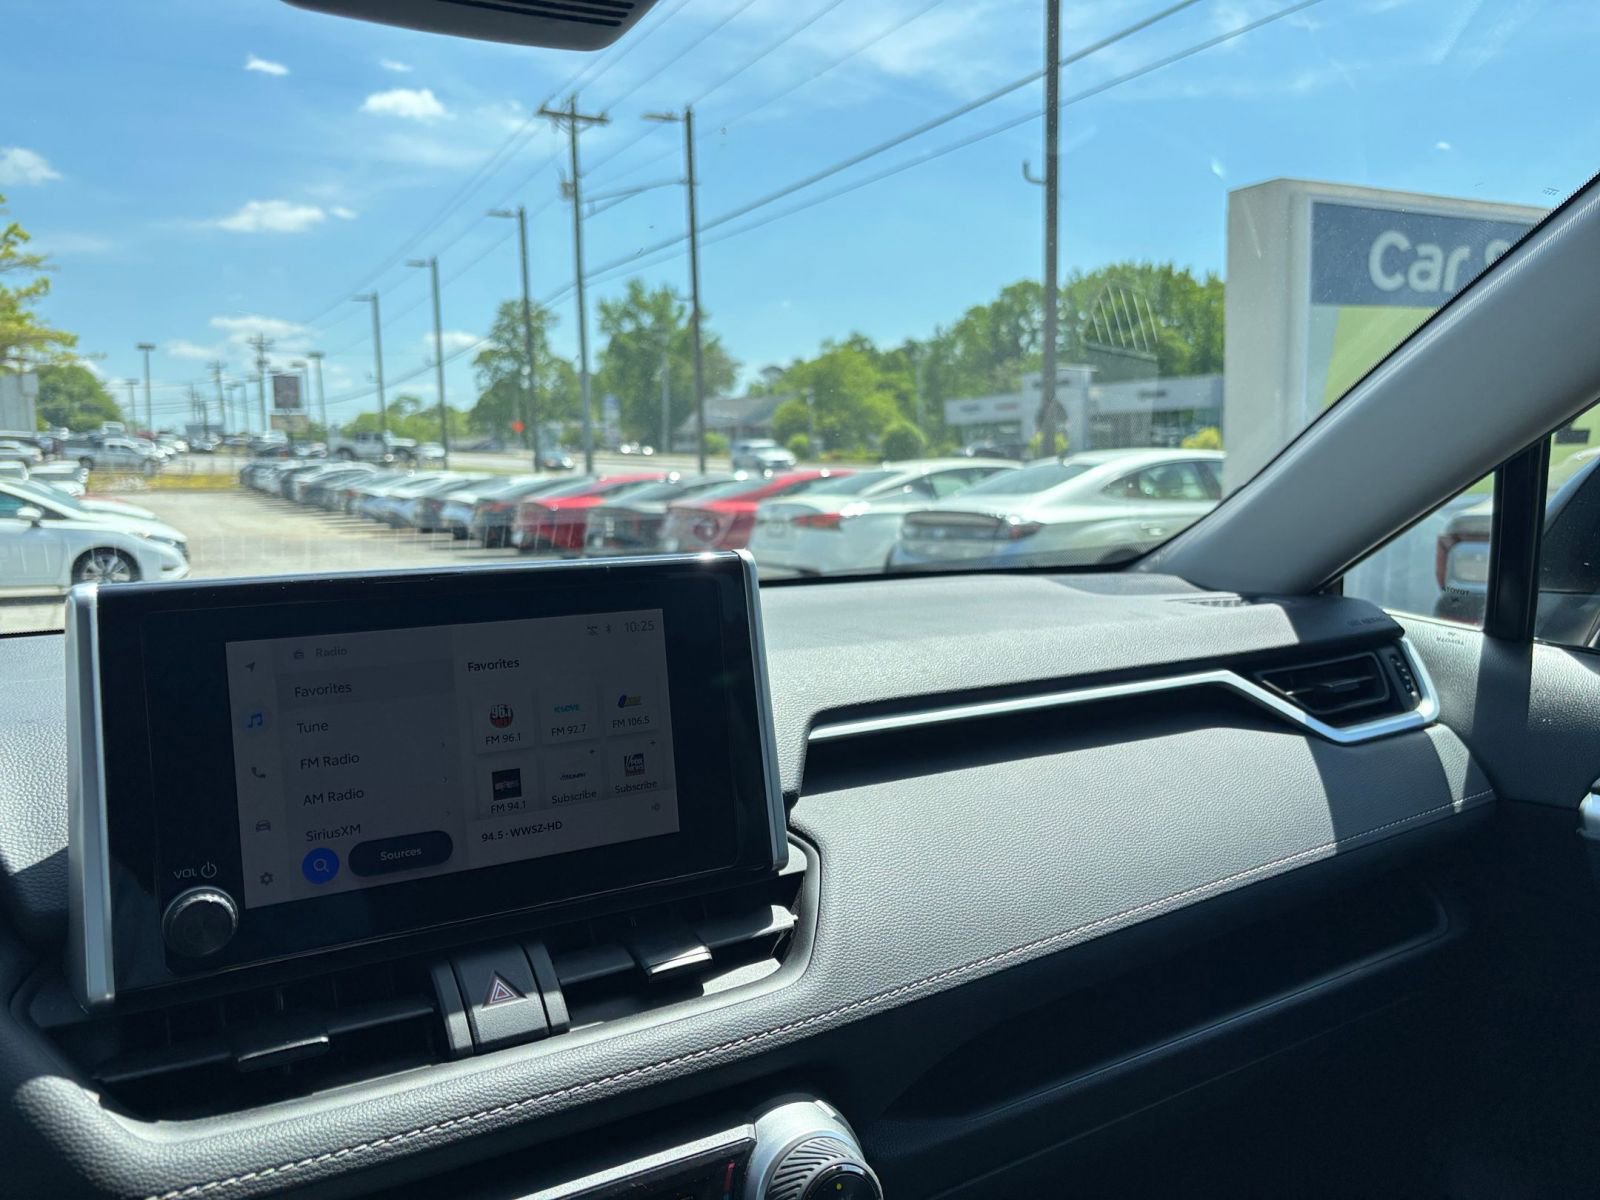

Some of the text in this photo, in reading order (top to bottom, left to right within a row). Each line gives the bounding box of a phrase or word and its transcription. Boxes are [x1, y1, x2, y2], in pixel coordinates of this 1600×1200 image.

[1367, 230, 1470, 293] Car
[624, 620, 655, 633] 10:25
[315, 646, 348, 658] Radio
[467, 657, 520, 673] Favorites
[294, 682, 352, 698] Favorites
[296, 721, 329, 735] Tune
[612, 715, 650, 729] FM 106.5
[551, 724, 587, 737] FM 92.7
[485, 732, 521, 746] FM 96.1
[300, 752, 360, 771] FM Radio
[615, 779, 658, 794] Subscribe
[303, 788, 365, 807] AM Radio
[551, 789, 597, 805] Subscribe
[490, 800, 526, 815] FM 94.1
[305, 823, 362, 842] SiriusXM
[481, 821, 563, 843] 94.5 WWSZ-HD
[380, 847, 423, 862] Sources
[173, 867, 198, 881] VOL
